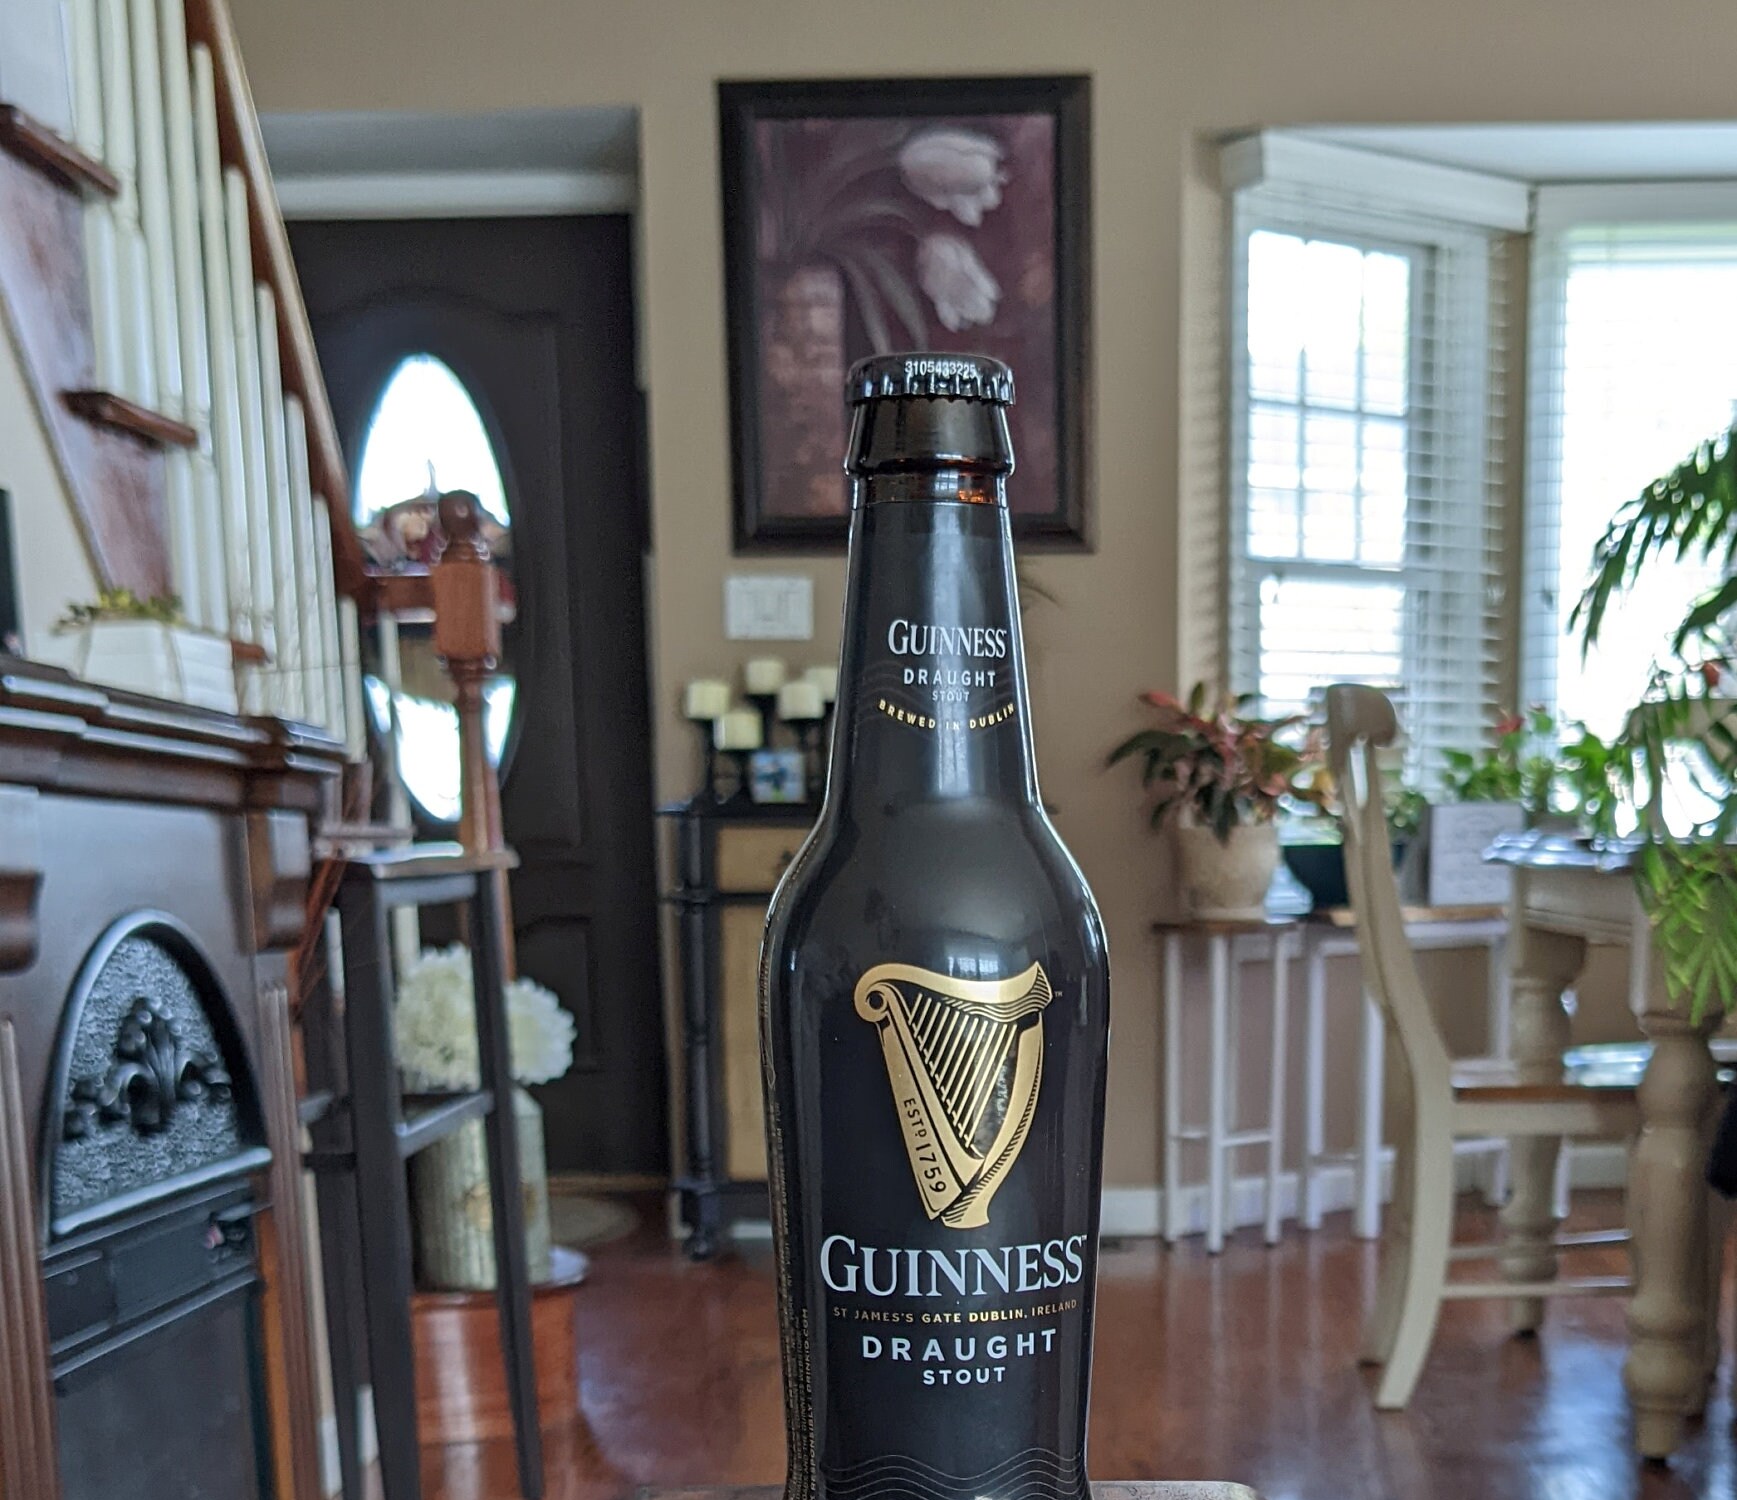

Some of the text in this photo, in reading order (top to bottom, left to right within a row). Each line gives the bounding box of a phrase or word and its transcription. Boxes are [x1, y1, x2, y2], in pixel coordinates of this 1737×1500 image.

[888, 619, 1007, 658] GUINNESS
[904, 668, 996, 687] DRAUGHT
[932, 691, 970, 702] STOUT
[878, 699, 1015, 730] BREWED IN DUBLIN
[915, 1143, 947, 1193] 1759
[820, 1234, 1085, 1297] GUINNESS
[833, 1307, 846, 1318] ST
[854, 1310, 914, 1323] JAMES'S
[922, 1313, 961, 1324] GATE
[1031, 1299, 1077, 1317] IRELAND
[862, 1328, 1056, 1362] DRAUGHT
[923, 1366, 1006, 1385] STOUT
[807, 1404, 817, 1491] RESPONSIBLY
